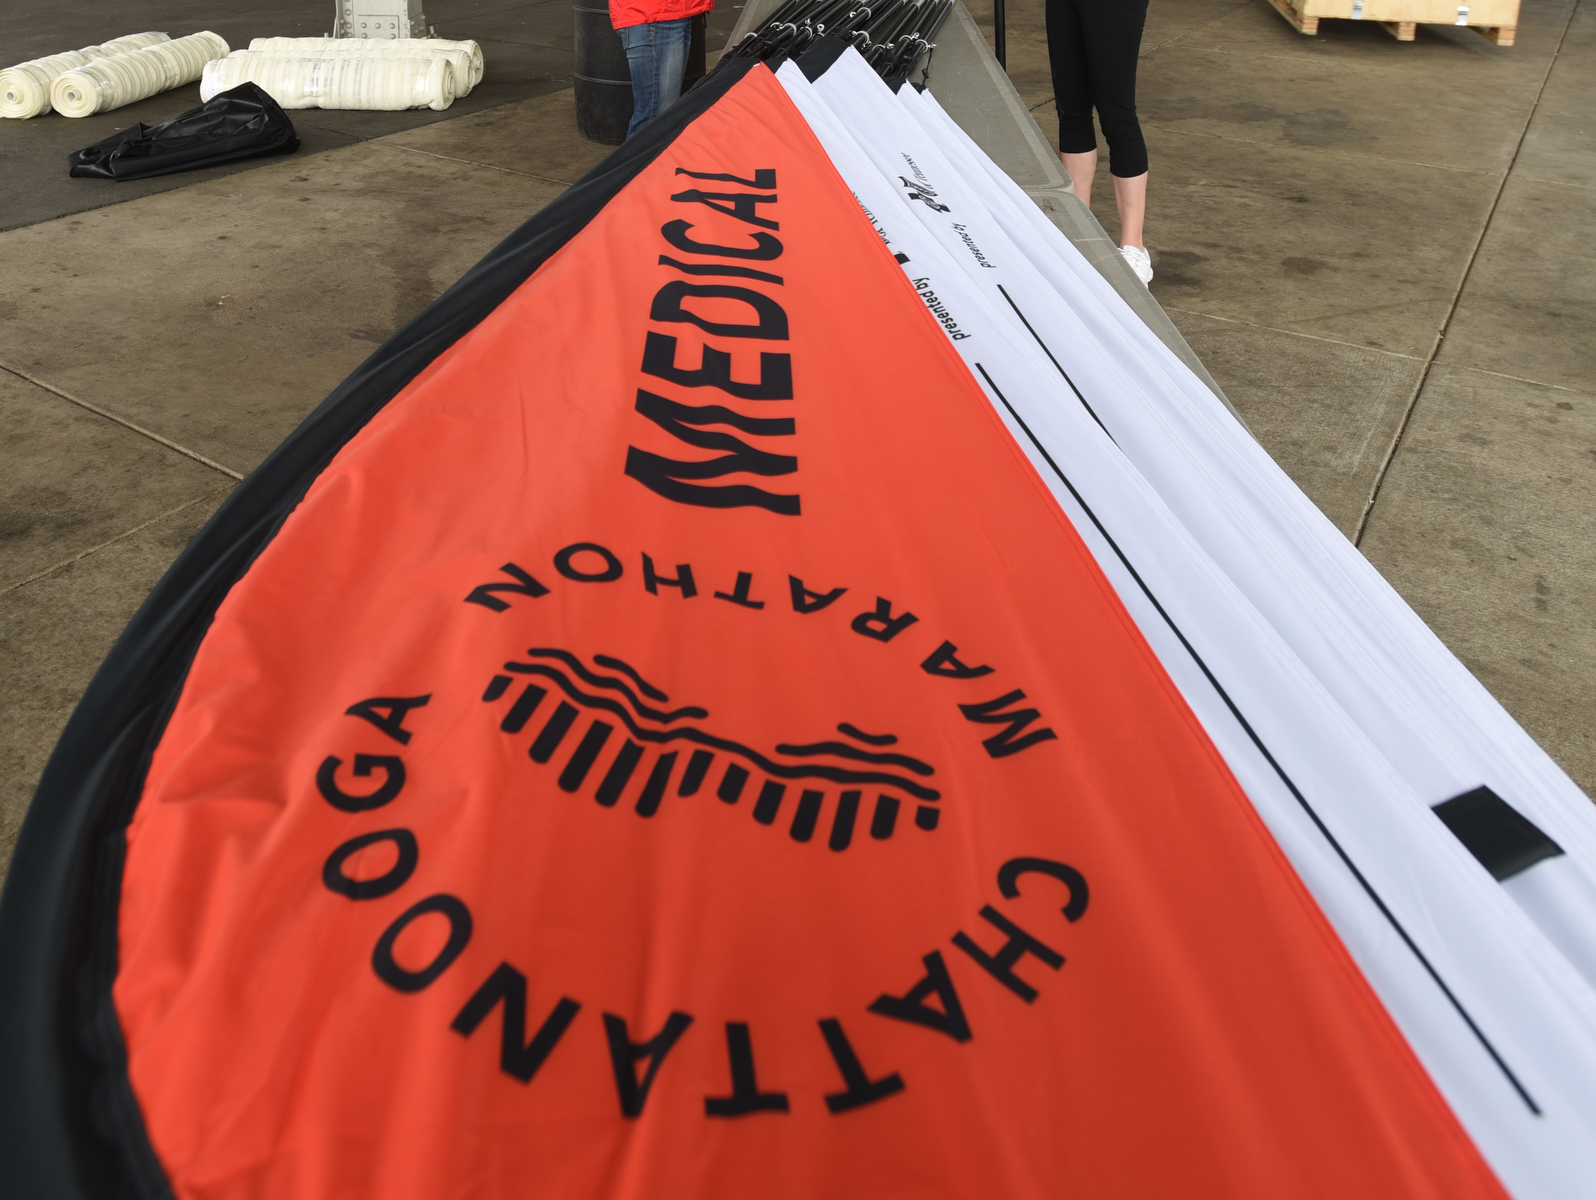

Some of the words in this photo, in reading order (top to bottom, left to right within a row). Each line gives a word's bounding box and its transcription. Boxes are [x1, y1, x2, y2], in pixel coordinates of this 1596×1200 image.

[951, 221, 966, 235] by
[956, 230, 996, 268] presented
[912, 277, 930, 291] by
[920, 287, 971, 341] presented
[624, 168, 801, 516] MEDICAL
[465, 542, 1057, 759] MARATHON
[315, 691, 1089, 1120] CHATTANOOGA
